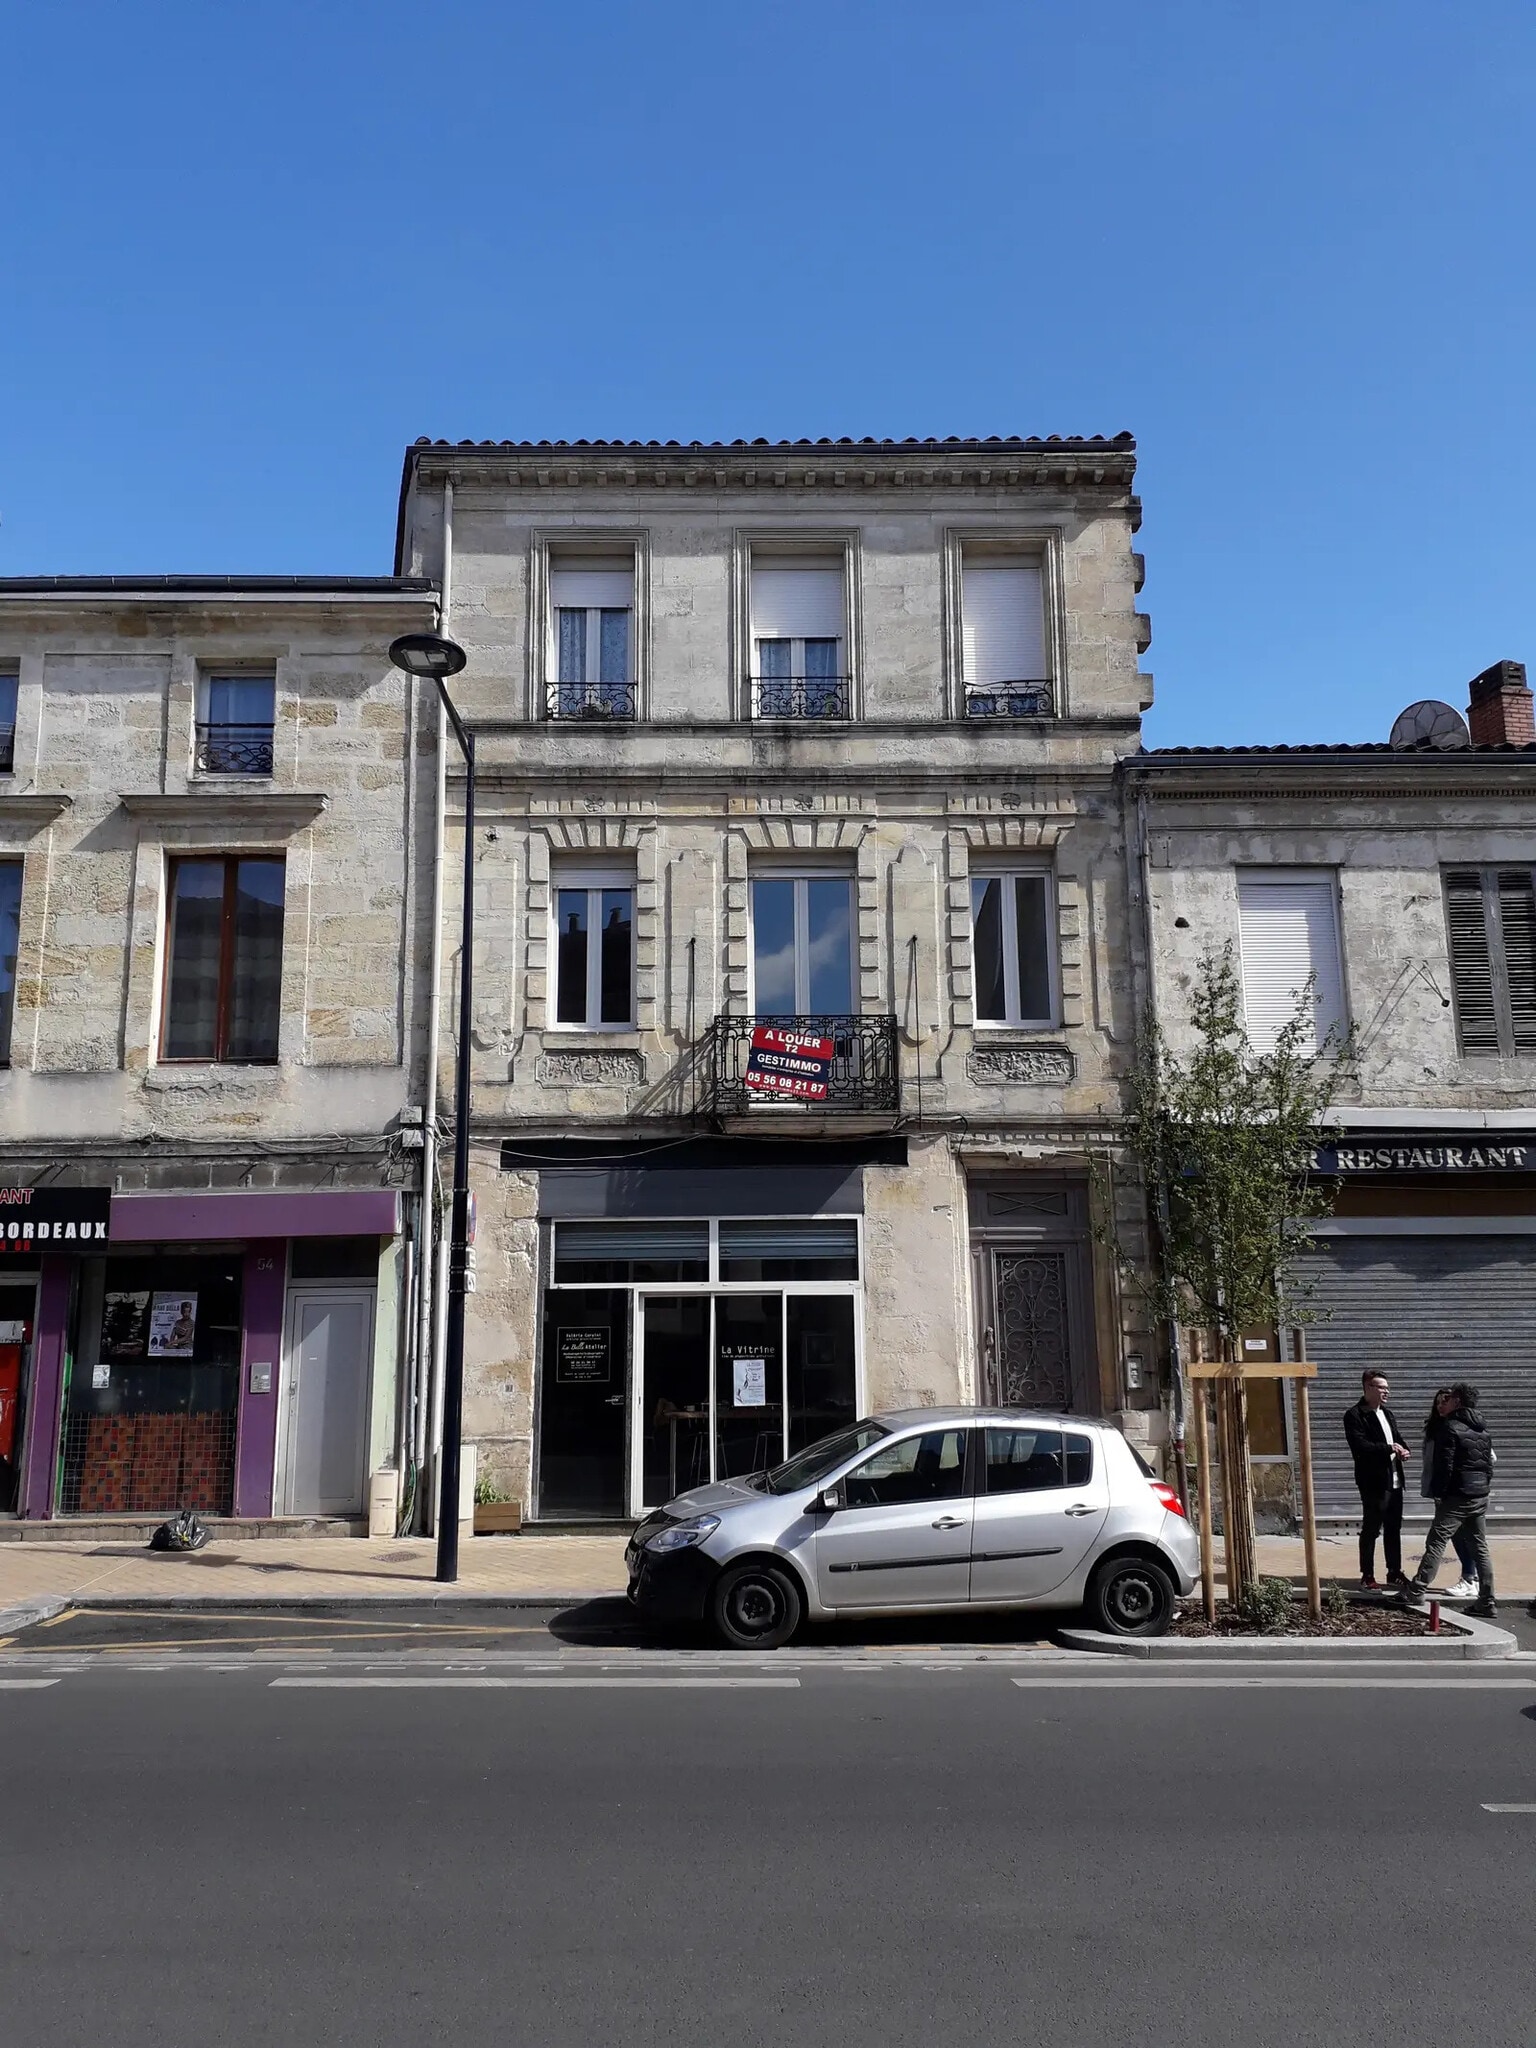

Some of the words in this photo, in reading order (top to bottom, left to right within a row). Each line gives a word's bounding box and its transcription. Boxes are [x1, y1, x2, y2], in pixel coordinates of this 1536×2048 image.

[765, 1030, 774, 1040] A
[778, 1032, 821, 1048] LOUER
[785, 1043, 798, 1054] T2
[757, 1053, 822, 1073] GESTIMMO
[748, 1072, 761, 1082] 05
[763, 1074, 776, 1085] 56
[779, 1077, 792, 1088] 08
[794, 1080, 808, 1091] 21
[811, 1083, 824, 1094] 87
[1336, 1147, 1527, 1170] RESTAURANT
[257, 1258, 273, 1271] 54
[722, 1345, 732, 1354] La
[737, 1345, 775, 1354] Vitrine
